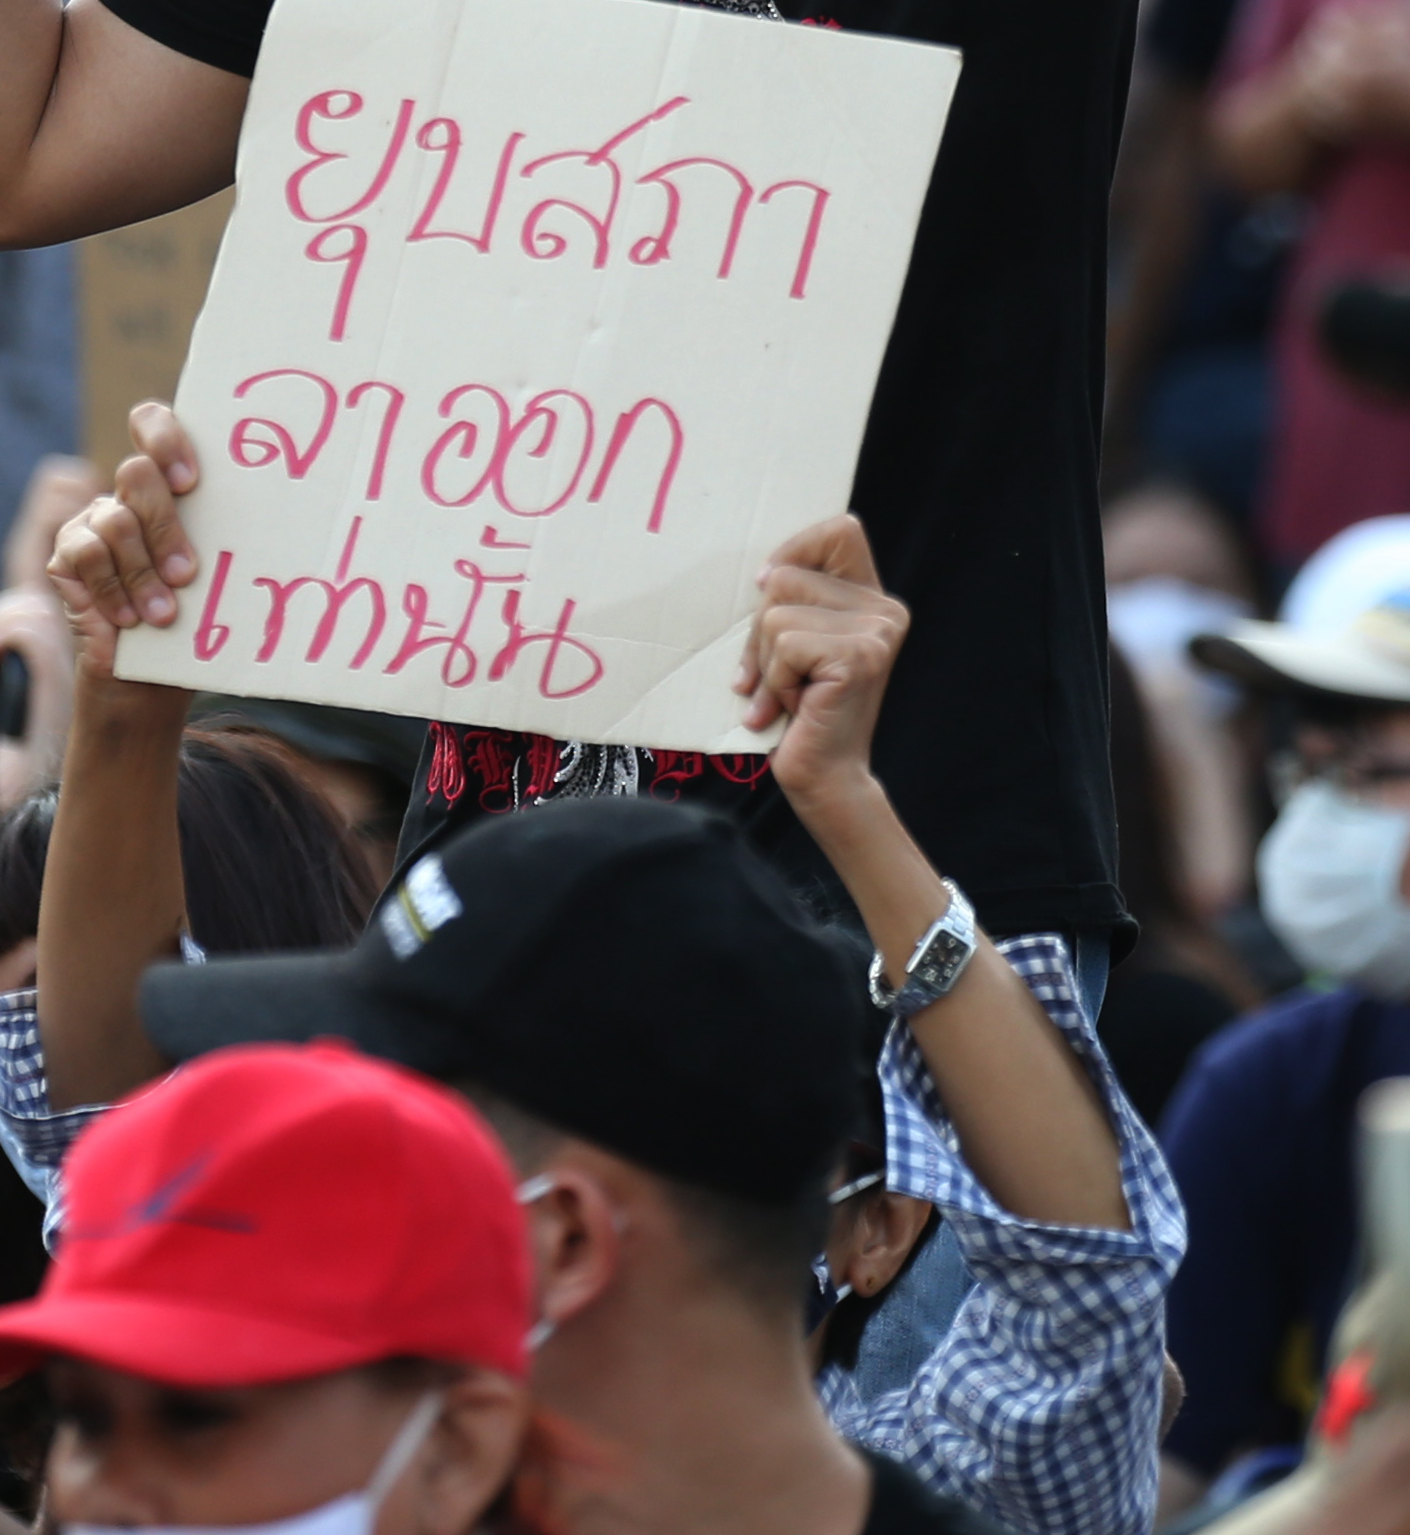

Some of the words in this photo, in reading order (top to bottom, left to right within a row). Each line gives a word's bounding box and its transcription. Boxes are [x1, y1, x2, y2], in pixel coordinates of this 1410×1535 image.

[285, 88, 831, 342] ยุบสภา
[228, 368, 685, 534] ลาออก
[193, 515, 605, 700] เท่านั้น
